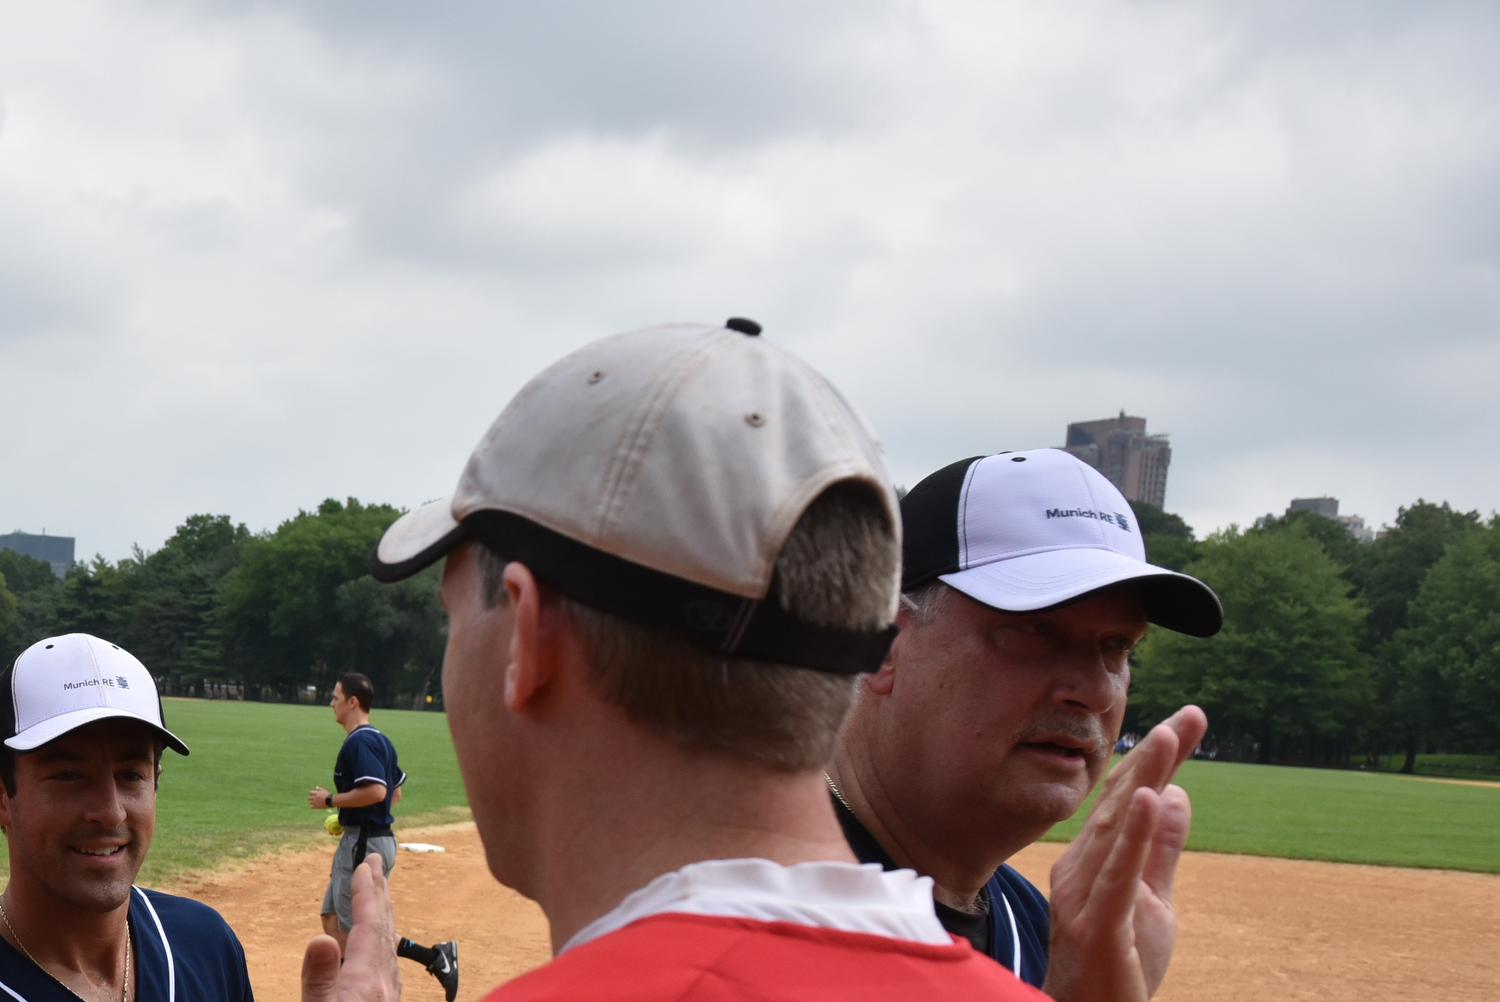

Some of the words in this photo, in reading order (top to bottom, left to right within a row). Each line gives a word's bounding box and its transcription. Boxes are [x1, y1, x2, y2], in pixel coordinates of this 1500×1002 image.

[1046, 508, 1098, 520] Munich
[1099, 511, 1115, 525] RE
[63, 678, 100, 691] Munich
